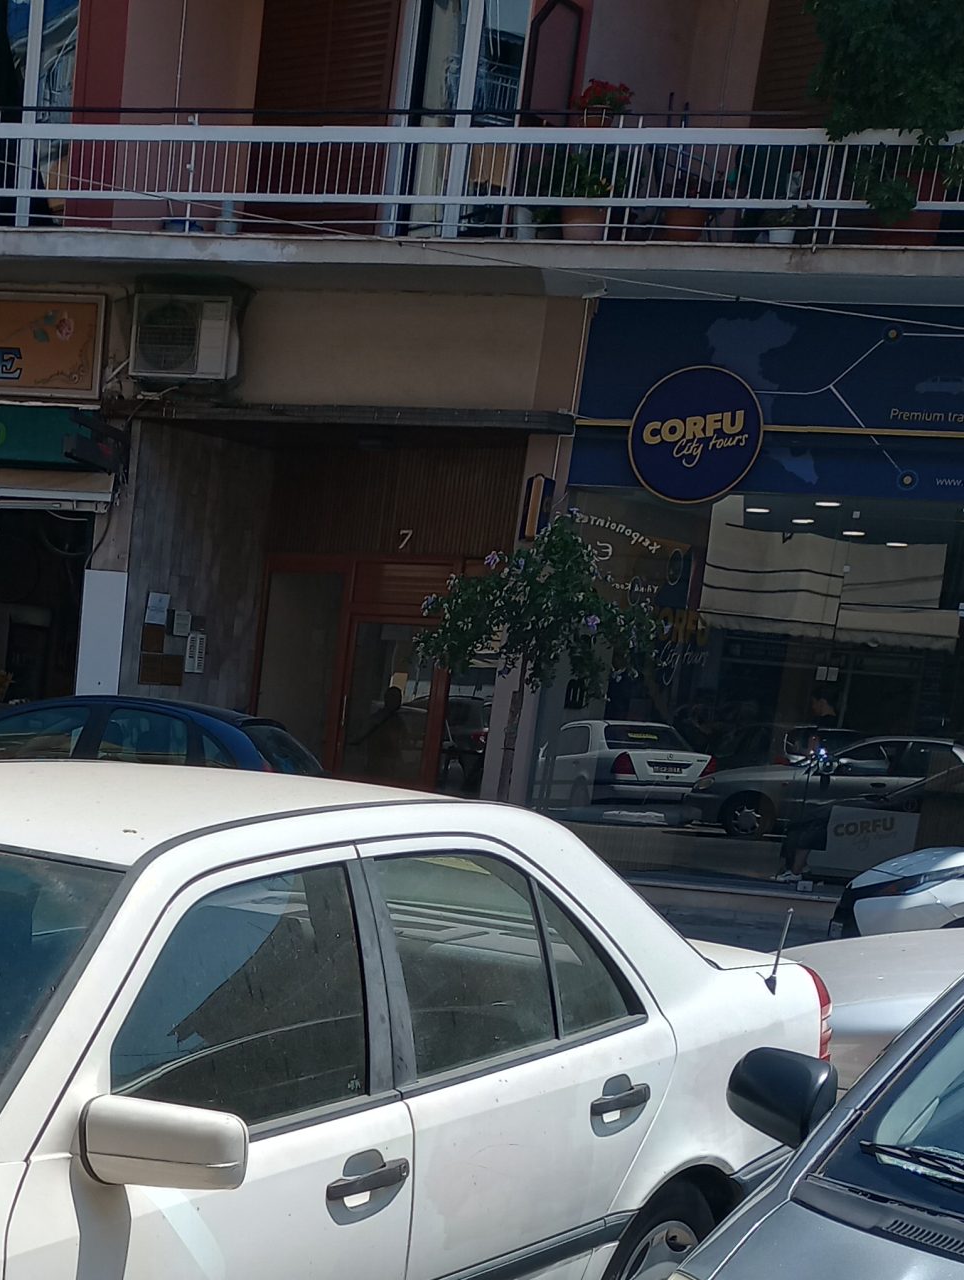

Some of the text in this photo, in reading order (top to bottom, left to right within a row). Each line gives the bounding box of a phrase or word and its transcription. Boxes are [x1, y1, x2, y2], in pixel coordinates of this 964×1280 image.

[889, 407, 945, 422] Premium
[642, 408, 745, 446] CORFU
[673, 431, 748, 469] City tours
[398, 529, 413, 549] 7
[832, 816, 895, 837] CORFU
